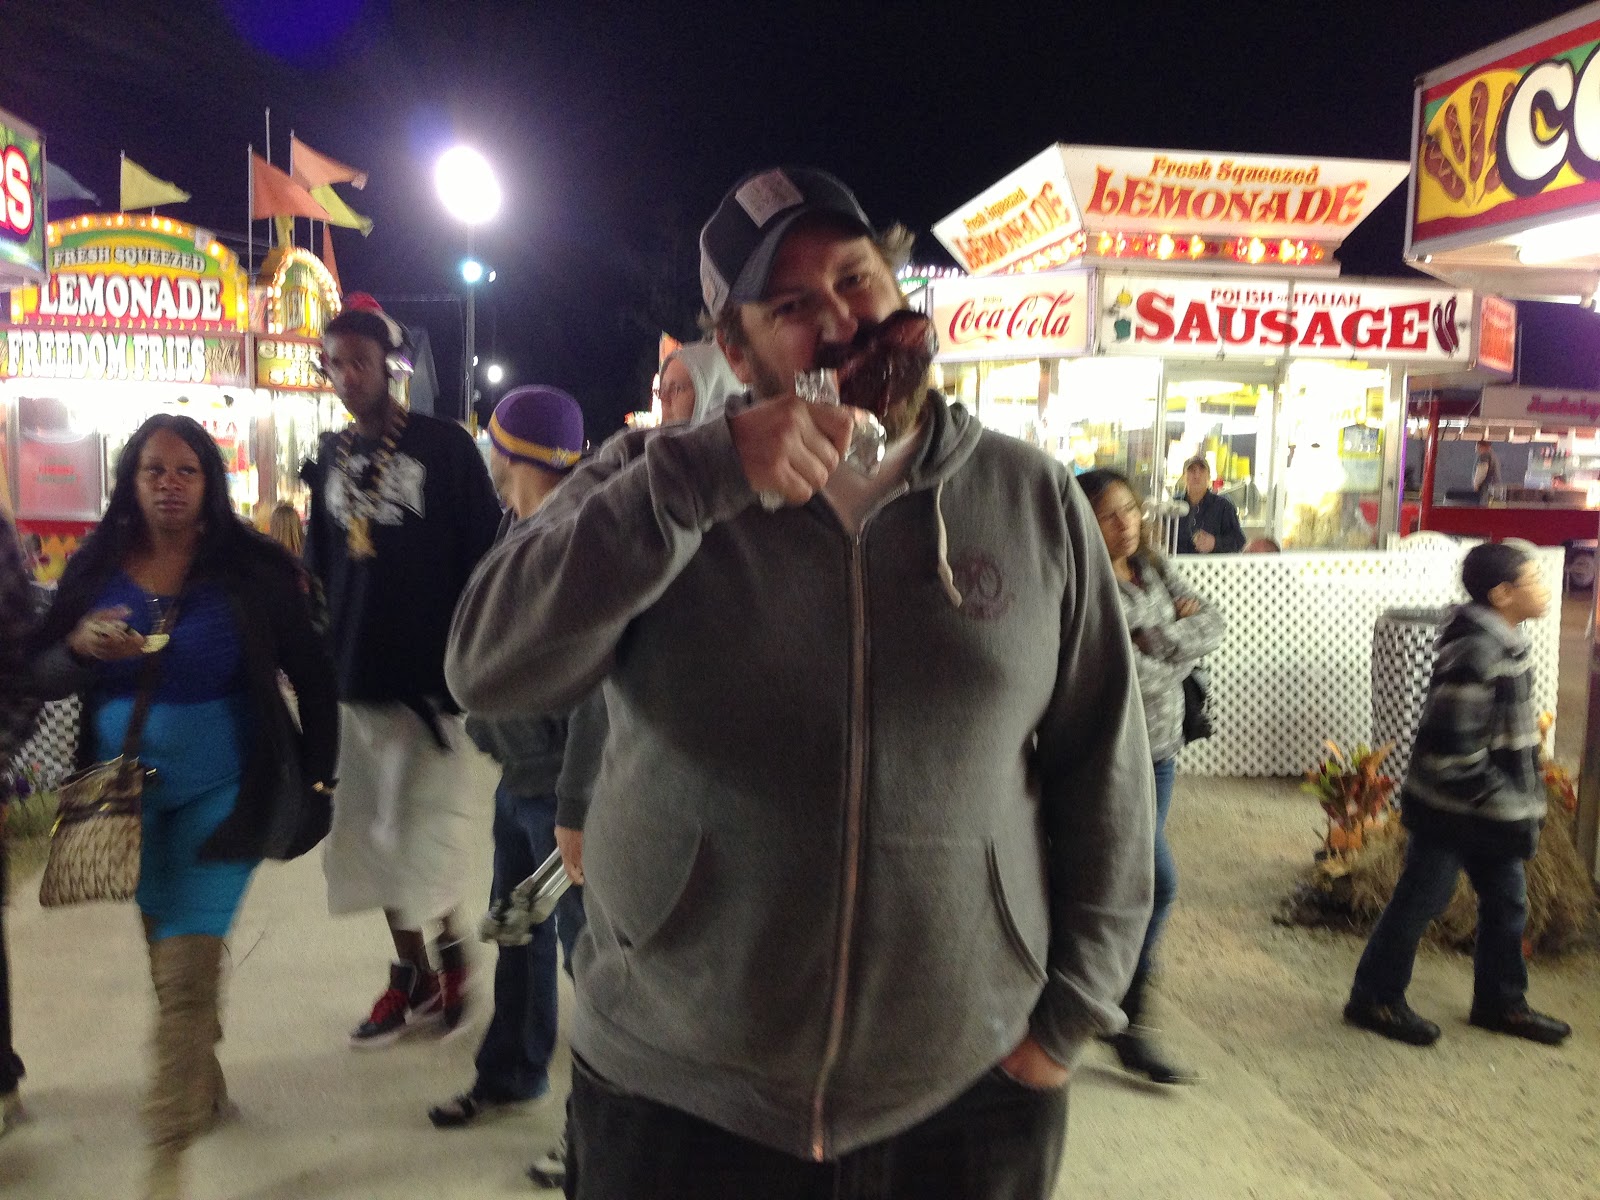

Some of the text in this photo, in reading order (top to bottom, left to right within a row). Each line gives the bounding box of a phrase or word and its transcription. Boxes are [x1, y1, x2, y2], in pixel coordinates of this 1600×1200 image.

[1087, 168, 1366, 225] LEMONADE
[1151, 157, 1319, 187] Fresh Squeezed
[954, 181, 1071, 271] LEMONADE
[53, 246, 206, 273] FRESH SQUEEZED
[39, 274, 222, 322] LEMONADE
[1135, 289, 1430, 351] SAUSAGE
[1210, 287, 1273, 303] POLISH
[1294, 291, 1361, 308] ITALIAN
[7, 329, 207, 383] FREEDOM FRIES
